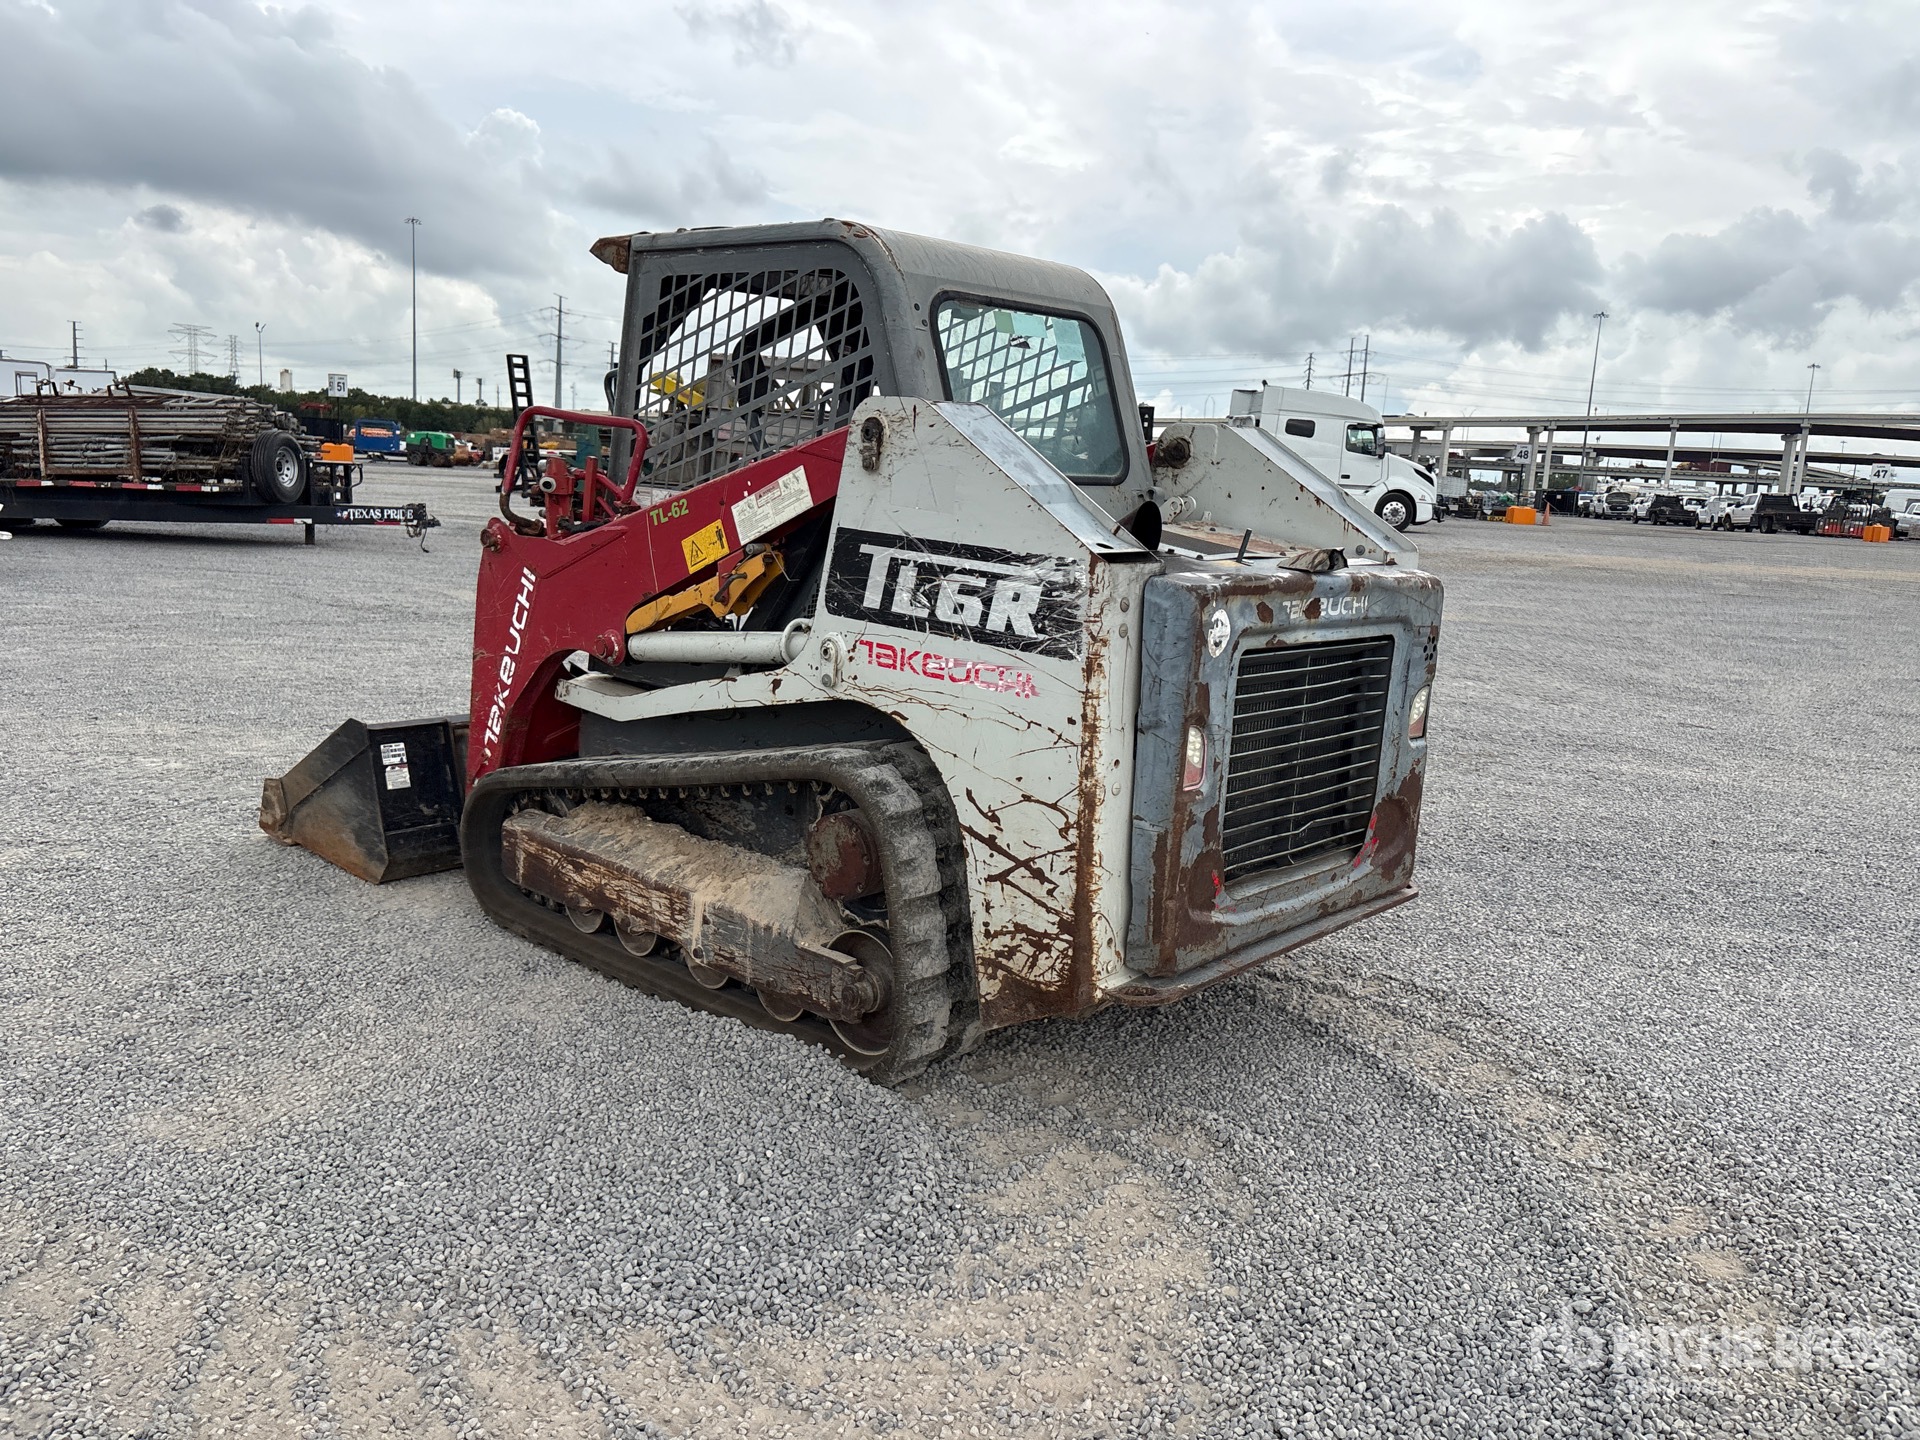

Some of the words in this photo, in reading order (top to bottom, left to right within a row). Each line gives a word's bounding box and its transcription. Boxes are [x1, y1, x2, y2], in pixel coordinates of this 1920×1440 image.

[336, 381, 346, 392] 51
[1517, 450, 1529, 459] 48
[1873, 470, 1888, 478] 47
[348, 508, 381, 521] TEXAS
[383, 509, 413, 520] PRIDE
[650, 499, 689, 526] TL-62
